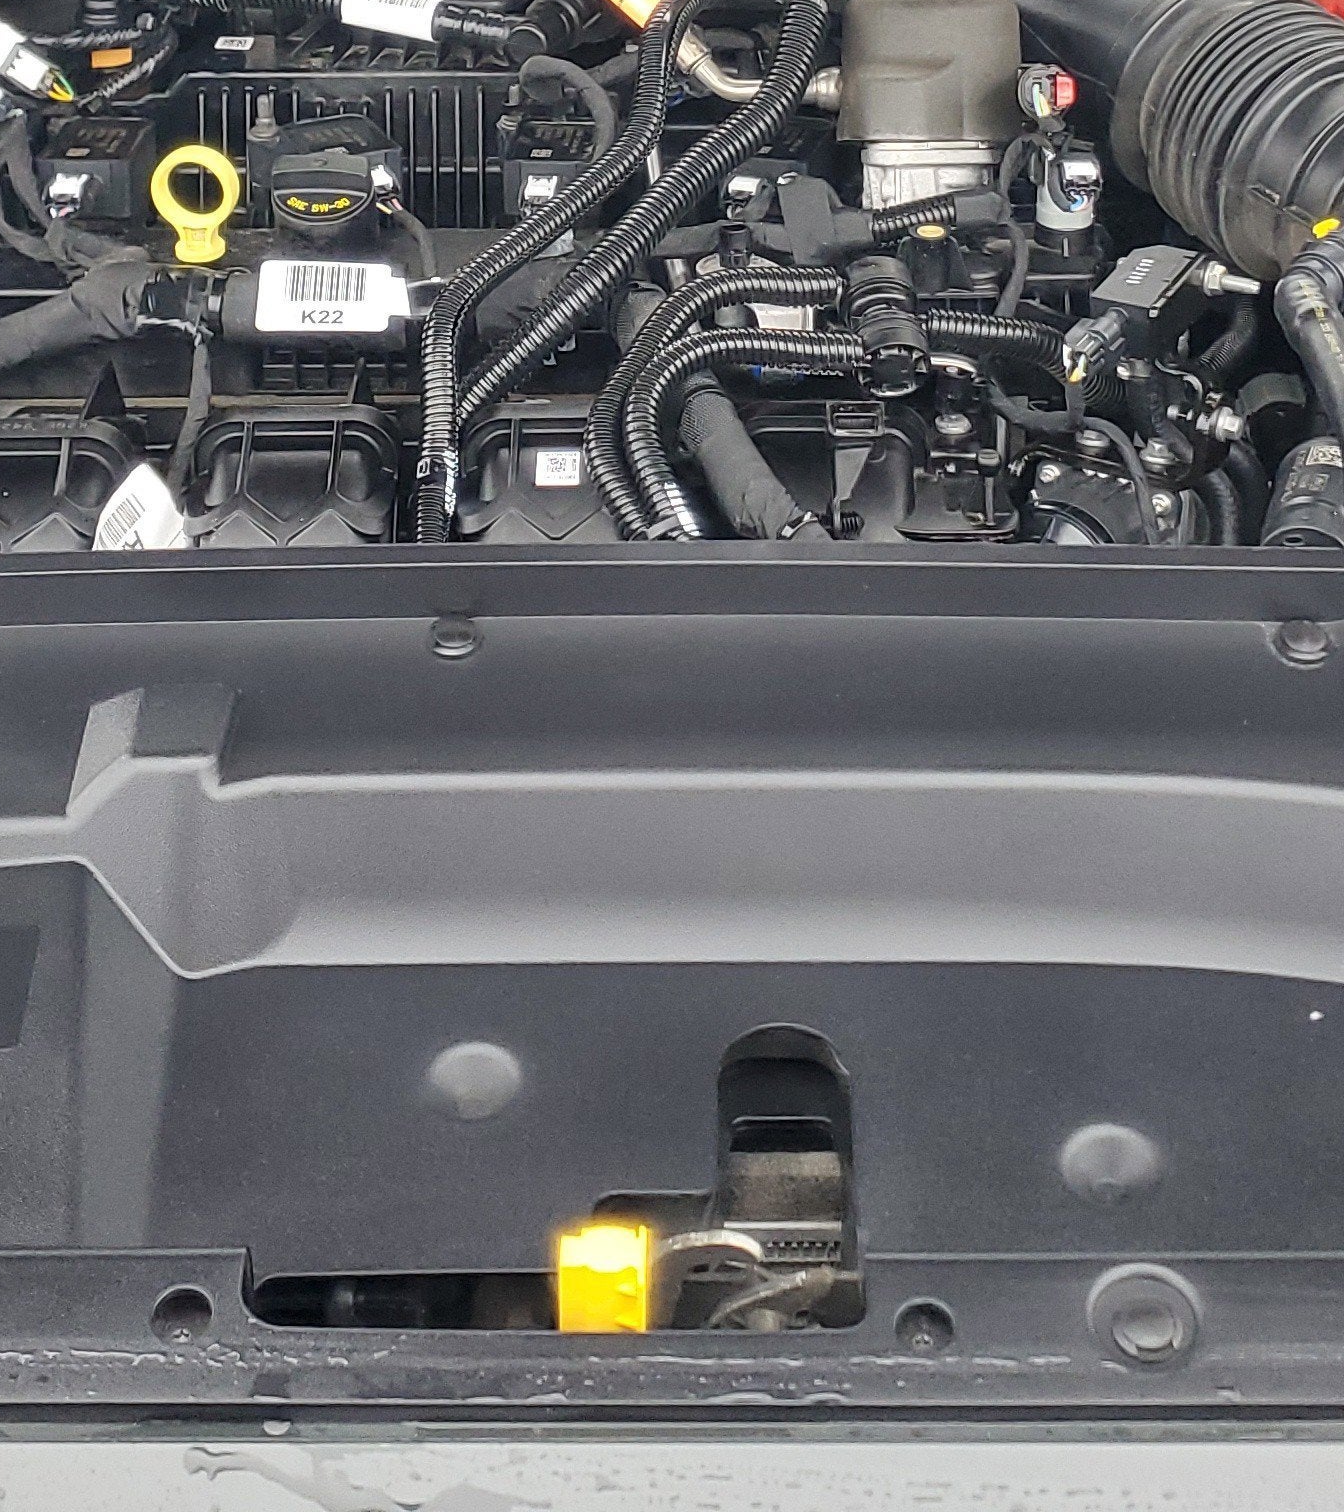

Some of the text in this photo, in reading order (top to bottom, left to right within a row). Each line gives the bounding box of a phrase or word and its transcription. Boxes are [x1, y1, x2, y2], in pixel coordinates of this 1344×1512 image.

[286, 196, 351, 213] SAE 5W-30
[301, 309, 344, 324] K22
